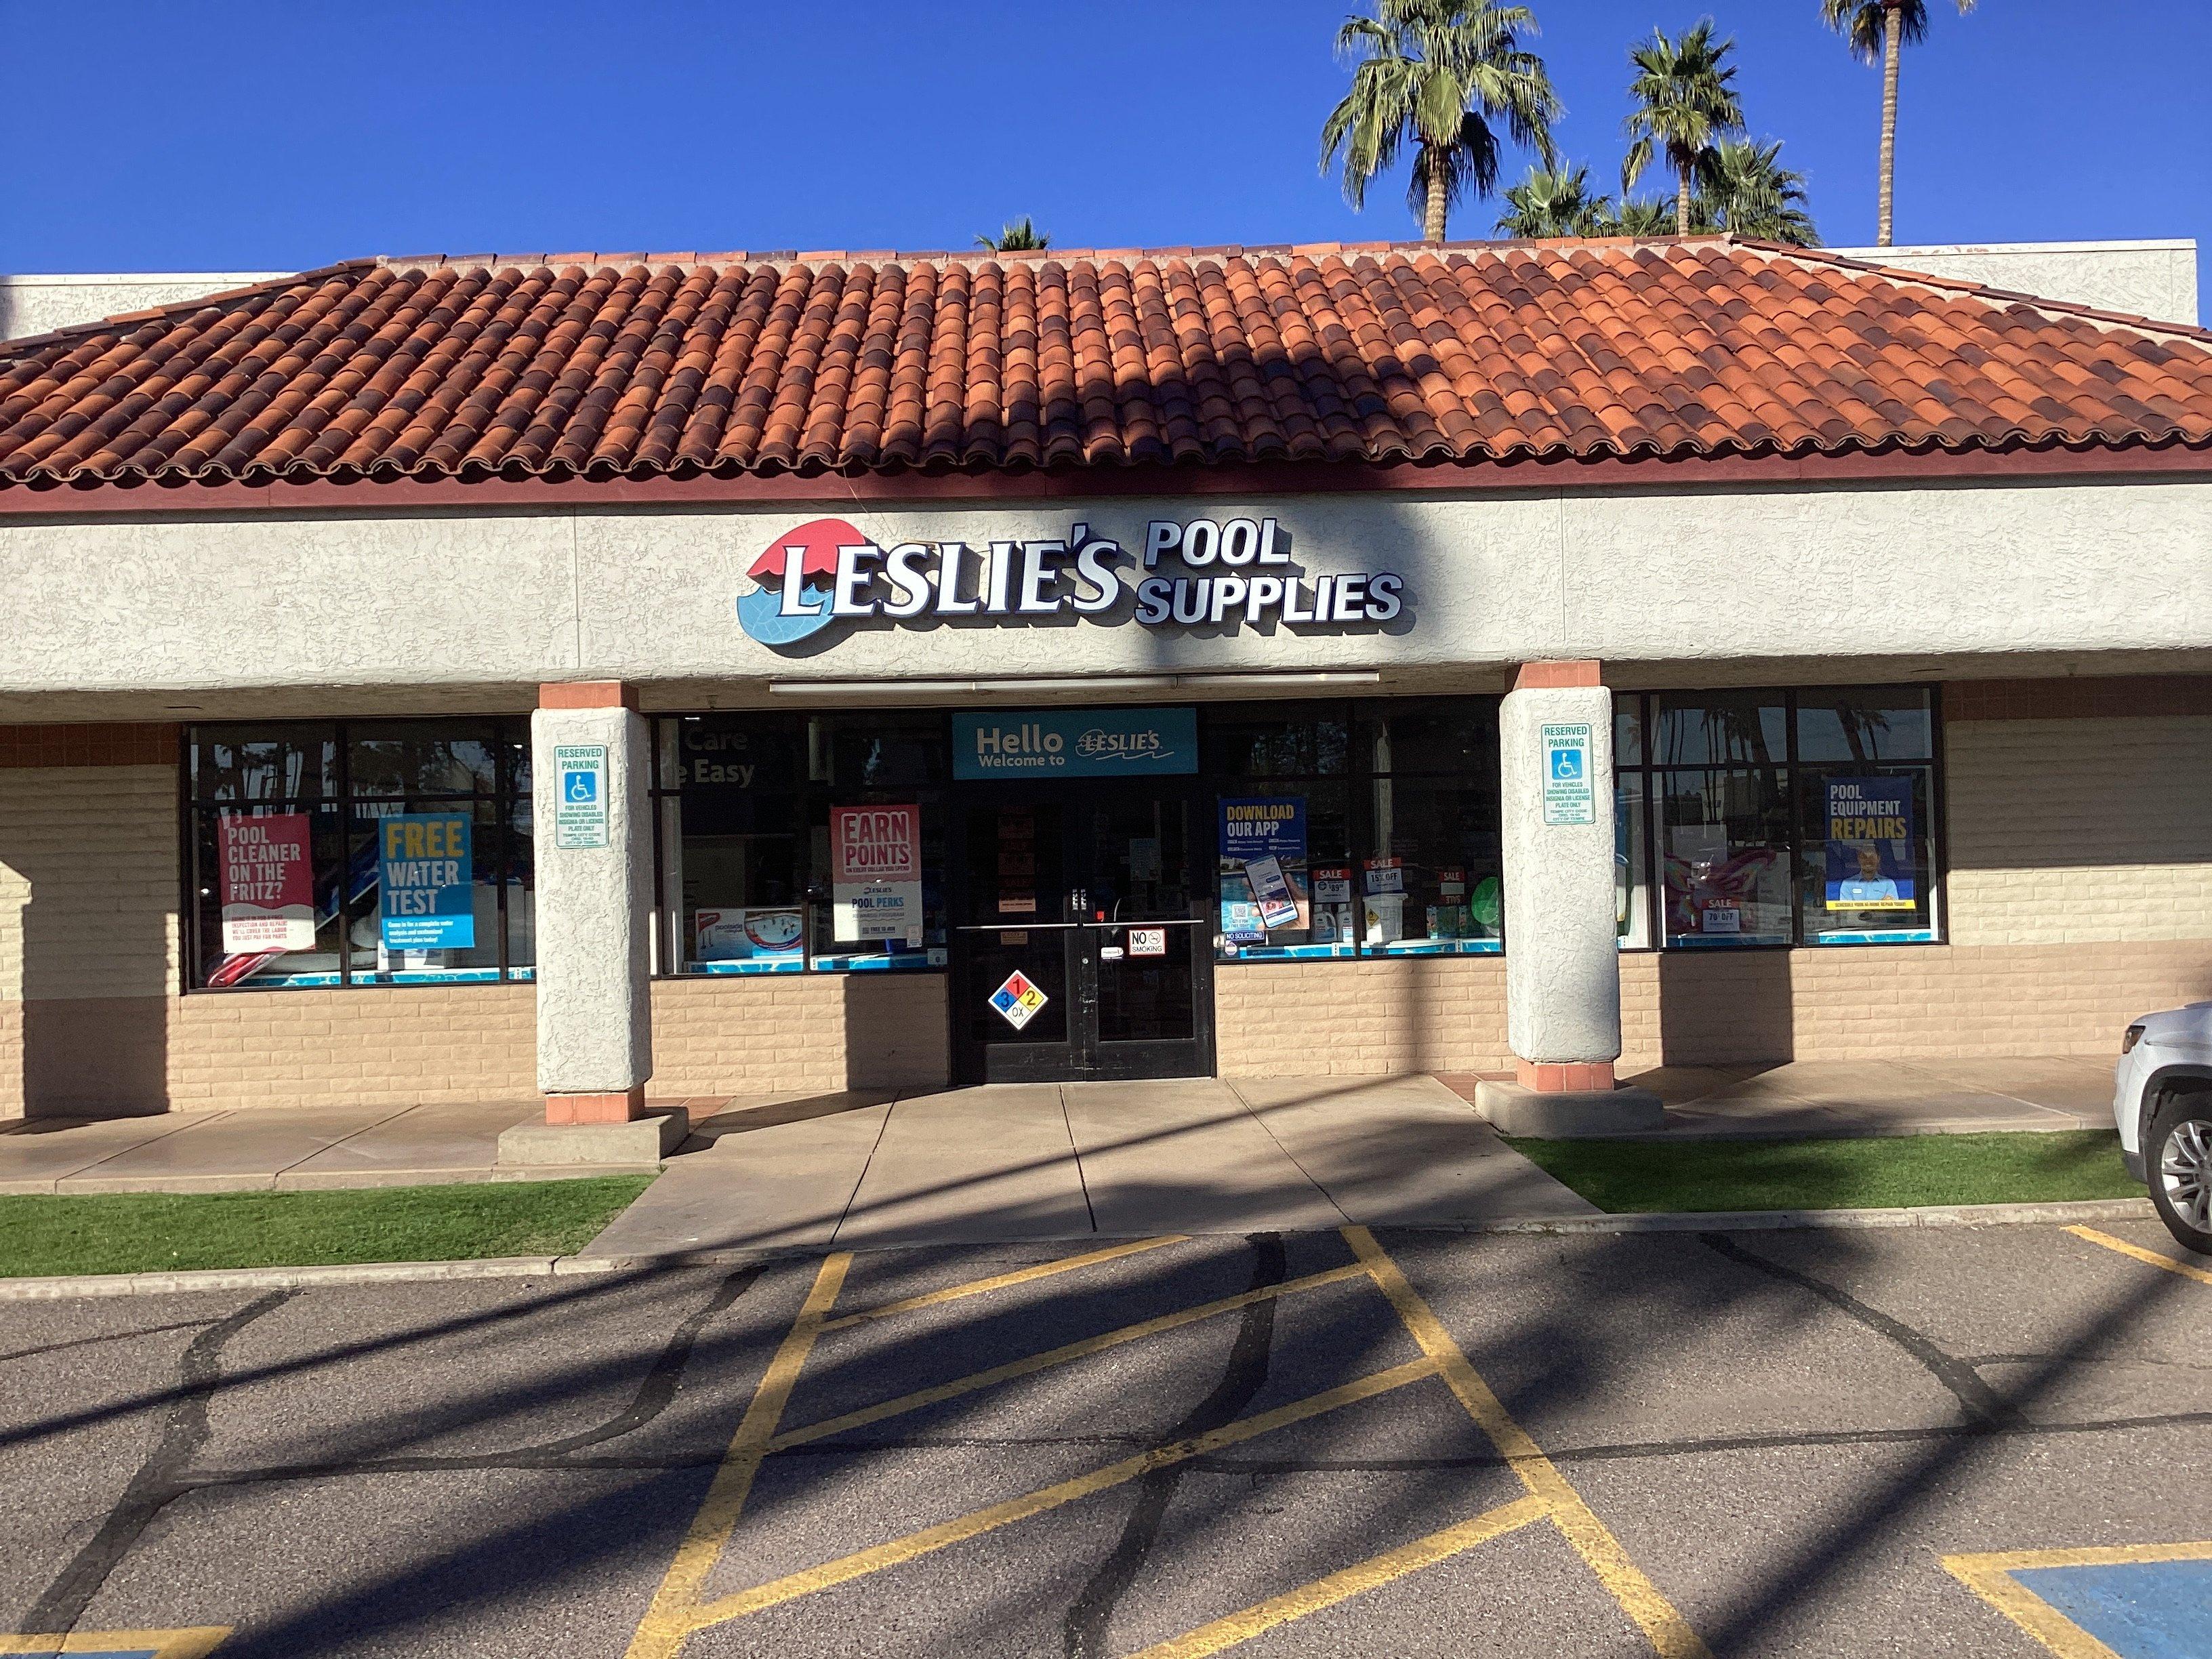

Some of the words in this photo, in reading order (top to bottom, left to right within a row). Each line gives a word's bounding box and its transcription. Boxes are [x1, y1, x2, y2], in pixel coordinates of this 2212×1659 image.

[1143, 517, 1292, 568] POOL
[779, 522, 1120, 617] LESLIE'S
[1134, 571, 1404, 626] SUPPLIES
[685, 728, 748, 751] Care
[977, 724, 1063, 754] Hello
[1544, 726, 1587, 736] RESERVED
[1084, 729, 1160, 752] LESLIE'S
[1549, 737, 1584, 747] PARKING
[558, 748, 602, 758] RESERVED
[978, 754, 1045, 767] Welcome
[1050, 754, 1065, 766] to
[562, 760, 599, 770] PARKING
[695, 758, 756, 788] Easy
[1830, 784, 1862, 800] POOL
[1227, 804, 1294, 821] DOWNLOAD
[1830, 800, 1901, 817] EQUIPMENT
[228, 826, 270, 845] POOL
[844, 813, 907, 844] EARN
[1227, 821, 1252, 837] OUR
[1254, 821, 1279, 836] APP
[1831, 817, 1906, 840] REPAIRS
[386, 821, 464, 859] FREE
[228, 843, 300, 864] CLEANER
[845, 843, 909, 866] POINTS
[229, 864, 250, 882] ON
[255, 862, 285, 882] THE
[1370, 858, 1394, 869] SALE
[386, 860, 459, 887] WATER
[1319, 869, 1343, 880] SALE
[1385, 872, 1398, 881] OFF
[1443, 872, 1460, 881] SALE
[230, 881, 283, 901] FRITZ?
[387, 888, 439, 915] TEST
[851, 898, 875, 909] POOL
[877, 897, 904, 907] PERKS
[1708, 899, 1732, 908] SALE
[1721, 912, 1734, 921] OFF
[715, 923, 743, 933] poolside
[1132, 932, 1147, 945] NO
[1012, 979, 1020, 995] 1
[1000, 991, 1010, 1008] 3
[1026, 989, 1036, 1006] 2
[1012, 1007, 1024, 1017] OX
